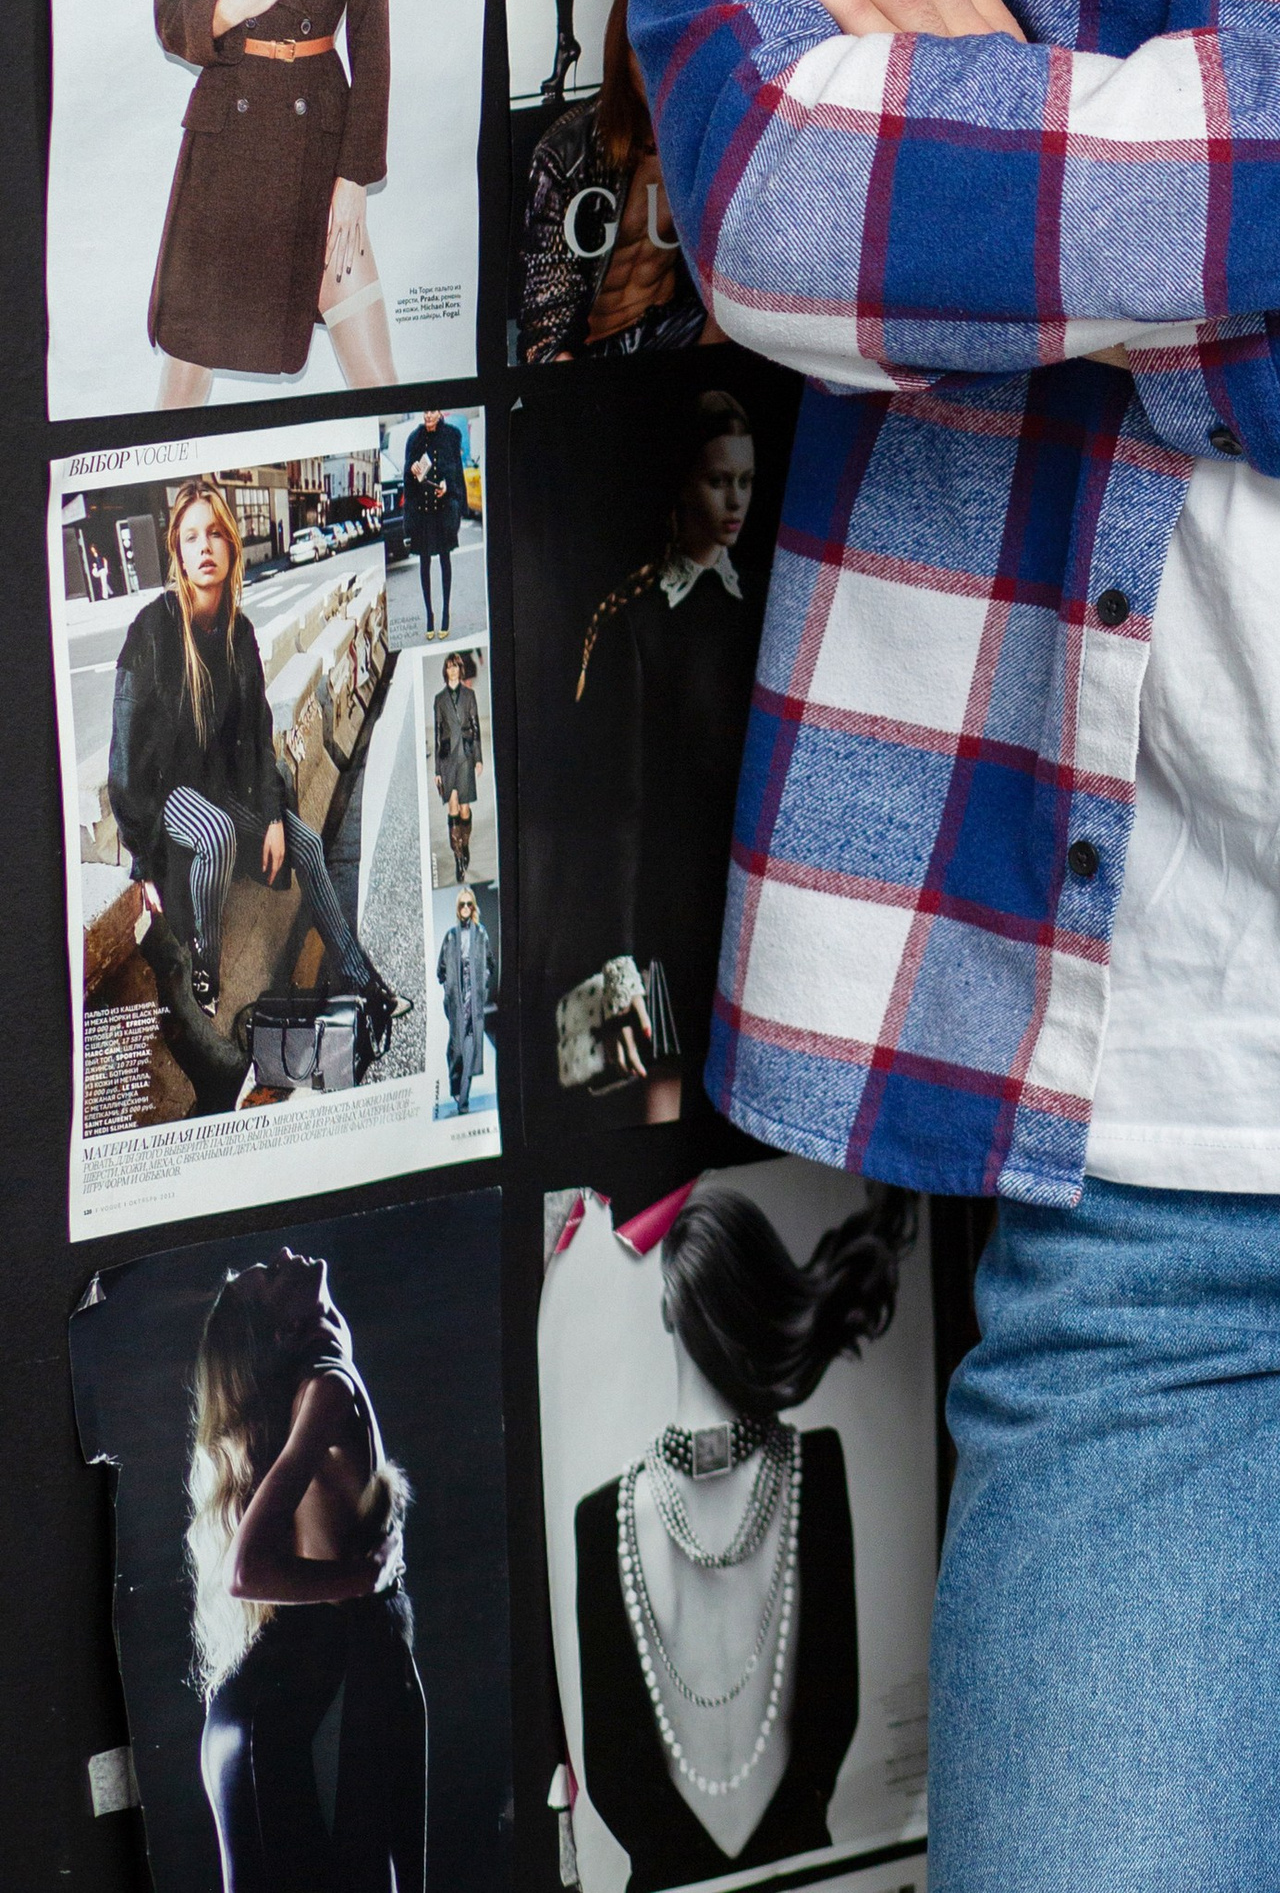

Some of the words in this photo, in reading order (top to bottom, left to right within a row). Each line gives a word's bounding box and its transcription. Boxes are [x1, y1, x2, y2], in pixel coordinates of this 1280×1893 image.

[420, 302, 444, 311] Michael
[395, 316, 412, 324] чулки
[69, 450, 130, 477] ВЫБОР
[135, 442, 190, 466] VOGUE
[84, 1009, 110, 1019] ПАЛЬТО
[110, 1007, 120, 1015] ИЗ
[120, 1001, 156, 1013] КАШЕМИРА
[90, 1017, 108, 1026] МЕХА
[109, 1014, 132, 1023] НОРКИ
[132, 1010, 152, 1020] BLACK
[152, 1006, 171, 1016] NAFA,
[84, 1027, 96, 1035] 189
[97, 1025, 109, 1033] 000
[84, 1032, 114, 1043] ПУЛОВЕР
[114, 1030, 123, 1038] ИЗ
[124, 1024, 160, 1036] КАШЕМИРА
[84, 1050, 103, 1059] MARC
[123, 1042, 149, 1052] ШЕЛКО-
[85, 1058, 99, 1066] ВЫЙ
[109, 1067, 139, 1078] БОТИНКИ
[84, 1083, 94, 1091] ИЗ
[94, 1080, 113, 1088] КОЖИ
[120, 1073, 151, 1083] МЕТАЛЛА,
[84, 1096, 116, 1105] КОЖАНАЯ
[116, 1090, 138, 1100] СУМКА
[93, 1088, 106, 1096] 000
[90, 1096, 149, 1112] МЕТАЛЛИЧЕСКИМИ
[129, 1105, 141, 1113] 000
[82, 1130, 194, 1162] МАТЕРИАЛЬНАЯ
[196, 1115, 270, 1141] ЦЕННОСТЬ
[272, 1102, 350, 1127] МНОГОСЛОЙНОСТЬ
[351, 1095, 382, 1111] МОЖНО
[84, 1120, 103, 1129] SAINT
[104, 1114, 132, 1125] LAURENT
[94, 1126, 109, 1134] HEDI
[116, 1155, 135, 1166] ДЛЯ
[136, 1150, 163, 1162] ЭТОГО
[163, 1140, 208, 1158] ВЫБЕРИТЕ
[247, 1123, 312, 1141] ВЫПОЛНЕННОЕ
[312, 1120, 322, 1129] ИЗ
[323, 1112, 358, 1128] РАЗНЫХ
[358, 1100, 408, 1121] МАТЕРИАЛОВ
[82, 1169, 119, 1184] ШЕРСТИ,
[120, 1163, 148, 1178] КОЖИ,
[175, 1156, 183, 1166] С
[183, 1148, 232, 1165] ВЯЗАНЫМИ
[283, 1134, 299, 1148] ЭТО
[299, 1125, 349, 1142] СОЧЕТАНИЕ
[350, 1117, 378, 1133] ФАКТУР
[82, 1184, 103, 1194] ИГРУ
[105, 1176, 129, 1189] ФОРМ
[130, 1174, 138, 1184] И
[101, 1203, 121, 1212] VOGUE
